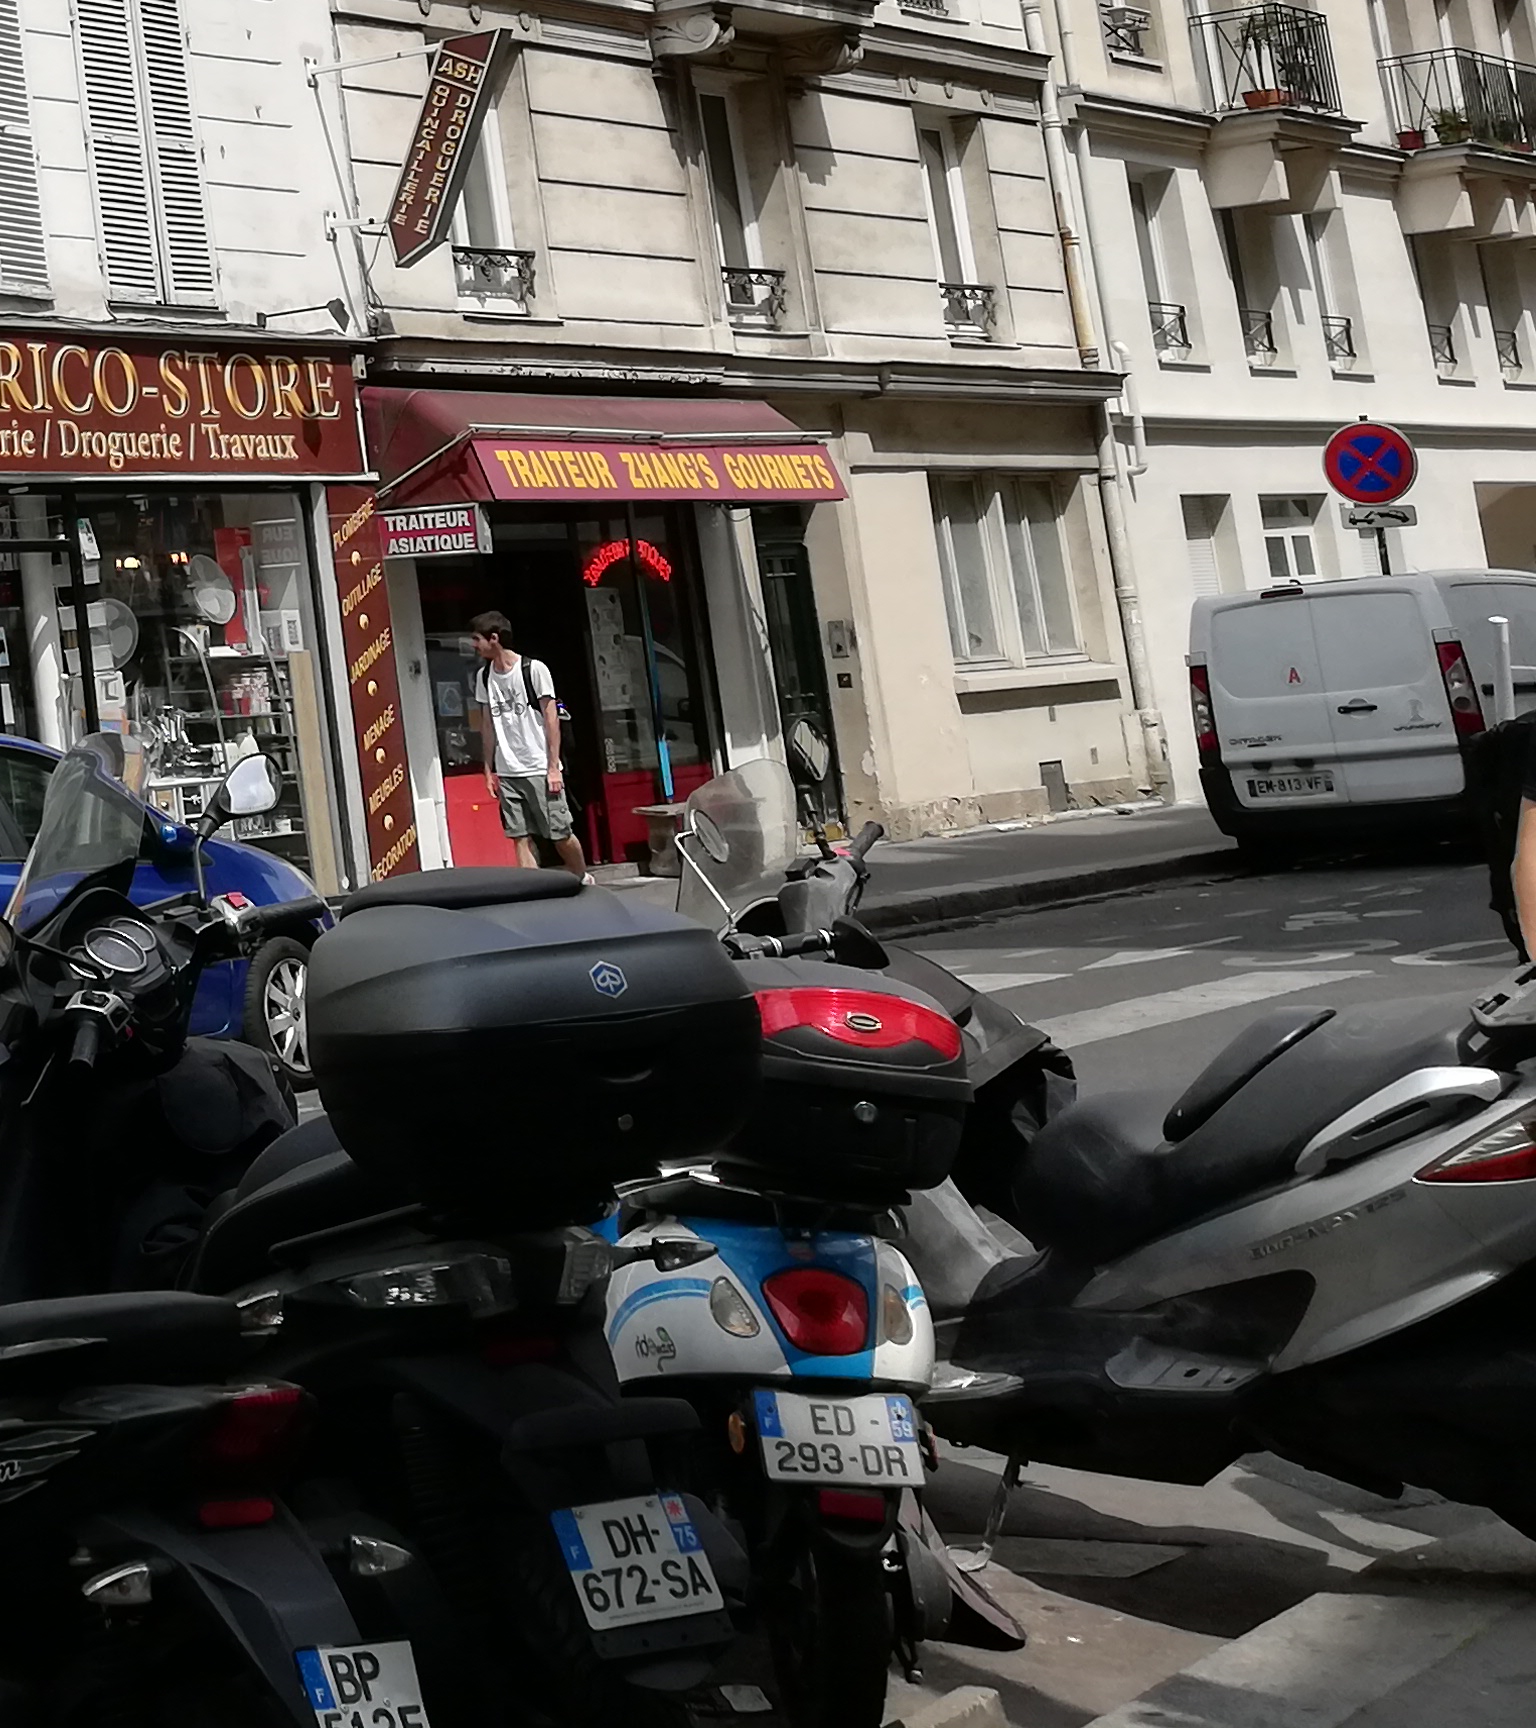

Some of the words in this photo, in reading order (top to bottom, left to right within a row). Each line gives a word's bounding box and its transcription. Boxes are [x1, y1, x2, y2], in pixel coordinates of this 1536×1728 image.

[438, 57, 483, 85] ASH
[392, 84, 451, 227] QUINCAILLERIE
[413, 92, 472, 236] DROGUERIE
[58, 419, 184, 470] Droguerie
[201, 424, 299, 462] Travaux
[494, 449, 619, 489] TRAITEUR
[618, 451, 720, 490] ZHANG'S
[722, 451, 835, 491] GOURMETS
[333, 496, 375, 553] PLOMBERIE
[383, 510, 471, 532] TRAITEUR
[388, 532, 476, 555] ASIATIQUE
[341, 562, 383, 617] OUTILLAGE
[350, 626, 391, 685] JARDINAGE
[1288, 667, 1301, 683] A
[363, 703, 395, 752] MENAGE
[368, 763, 404, 815] MEUBLES
[890, 1420, 914, 1438] 59
[774, 1440, 909, 1477] 293-DR
[673, 1525, 697, 1547] 75
[582, 1555, 714, 1613] 672-SA
[315, 1687, 325, 1703] F
[328, 1650, 380, 1705] BP
